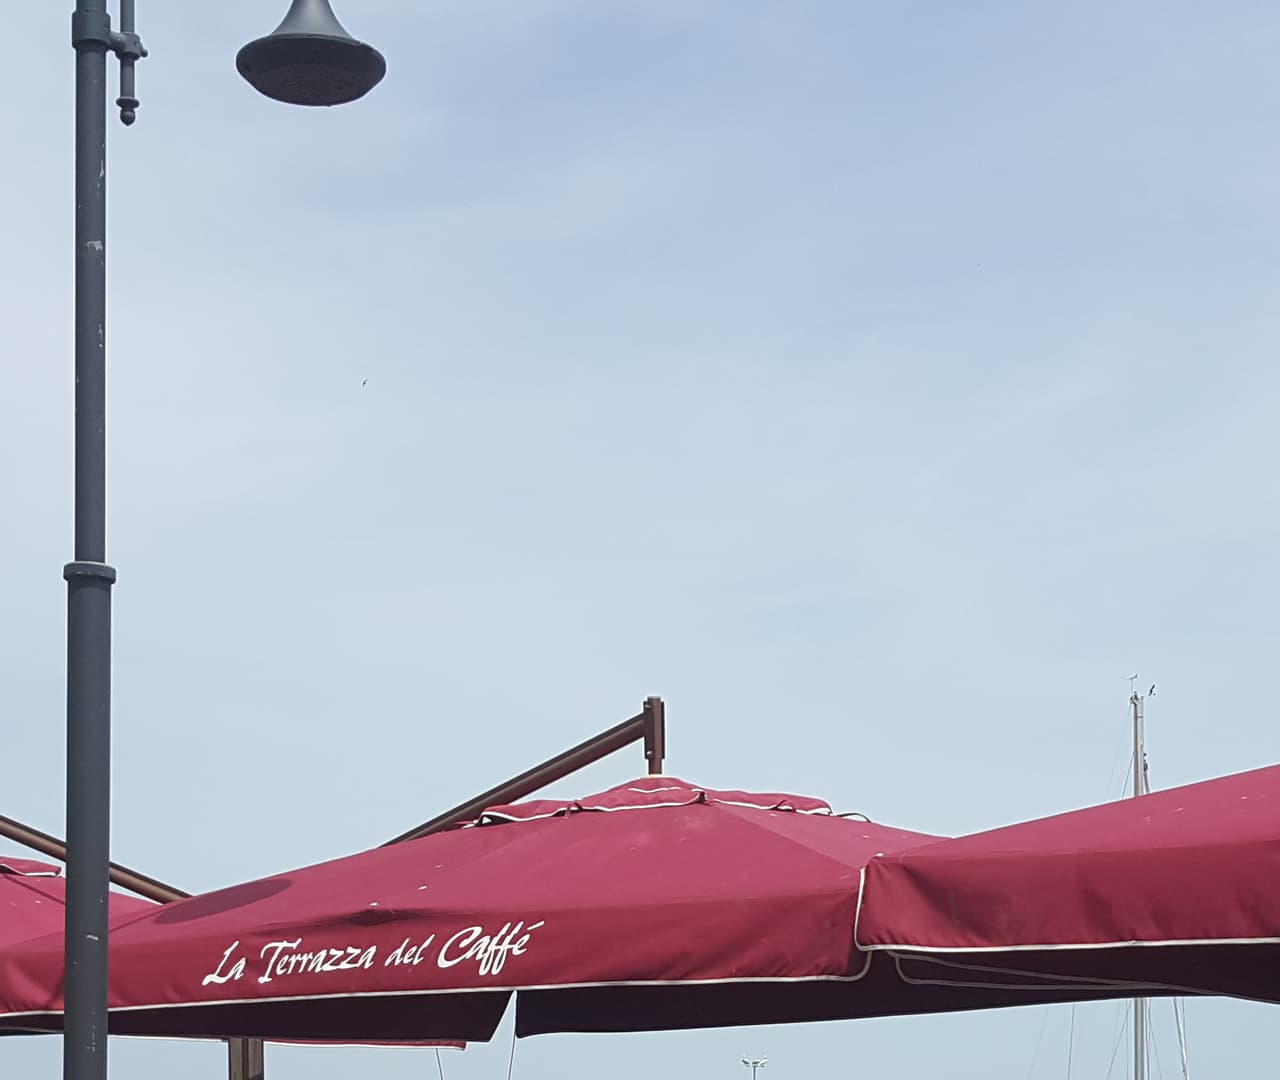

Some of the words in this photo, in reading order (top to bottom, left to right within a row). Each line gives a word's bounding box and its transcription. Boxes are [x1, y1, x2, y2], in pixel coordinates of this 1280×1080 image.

[201, 940, 247, 986] La
[257, 937, 378, 985] Terrazza
[384, 933, 436, 967] del
[436, 920, 546, 977] Caffé
